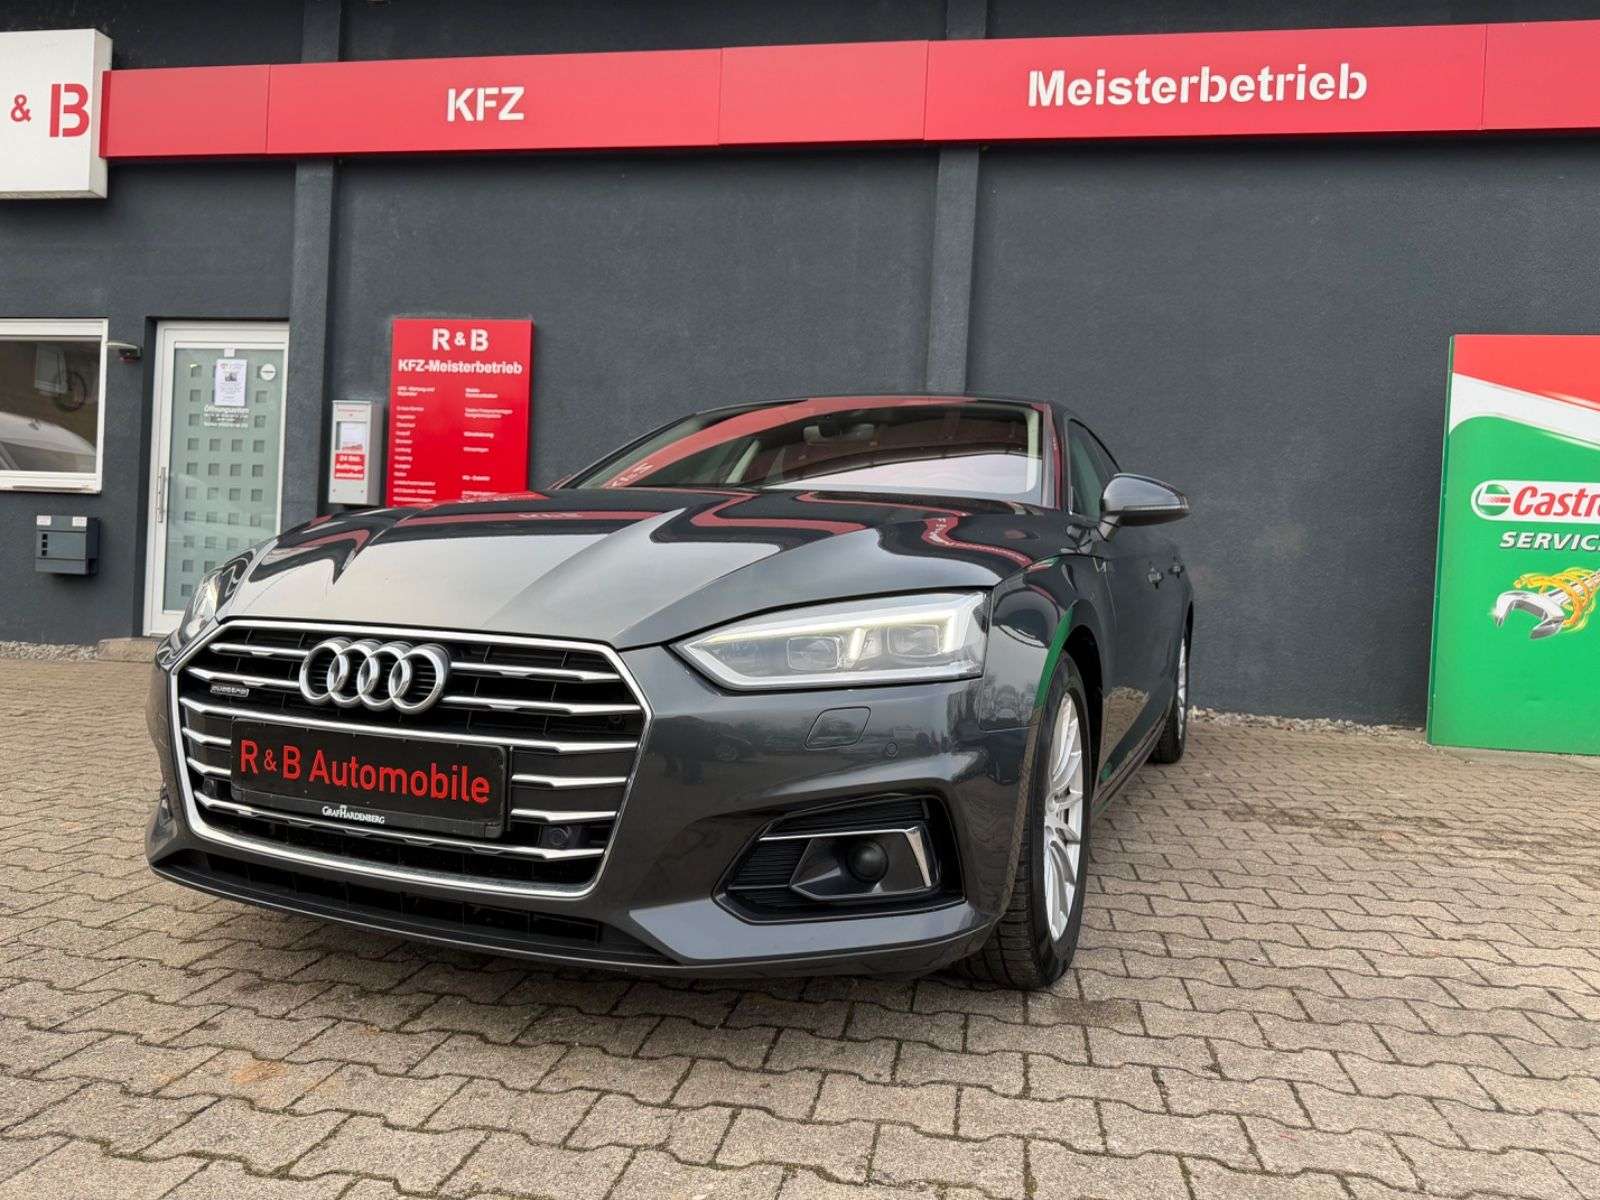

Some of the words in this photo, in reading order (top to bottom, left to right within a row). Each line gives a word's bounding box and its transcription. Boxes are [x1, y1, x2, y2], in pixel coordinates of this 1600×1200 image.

[1028, 63, 1368, 107] Meisterbetrieb
[11, 94, 31, 122] &
[49, 83, 89, 138] B
[447, 86, 525, 122] KFZ
[432, 328, 450, 351] R
[454, 332, 466, 346] &
[470, 328, 489, 352] B
[398, 359, 522, 374] KFZ-Meisterbetrieb
[1513, 486, 1600, 518] Castr
[1499, 531, 1600, 552] SERVIC
[239, 739, 258, 775] R
[264, 749, 278, 772] &
[282, 744, 301, 780] B
[308, 749, 491, 805] Automobile
